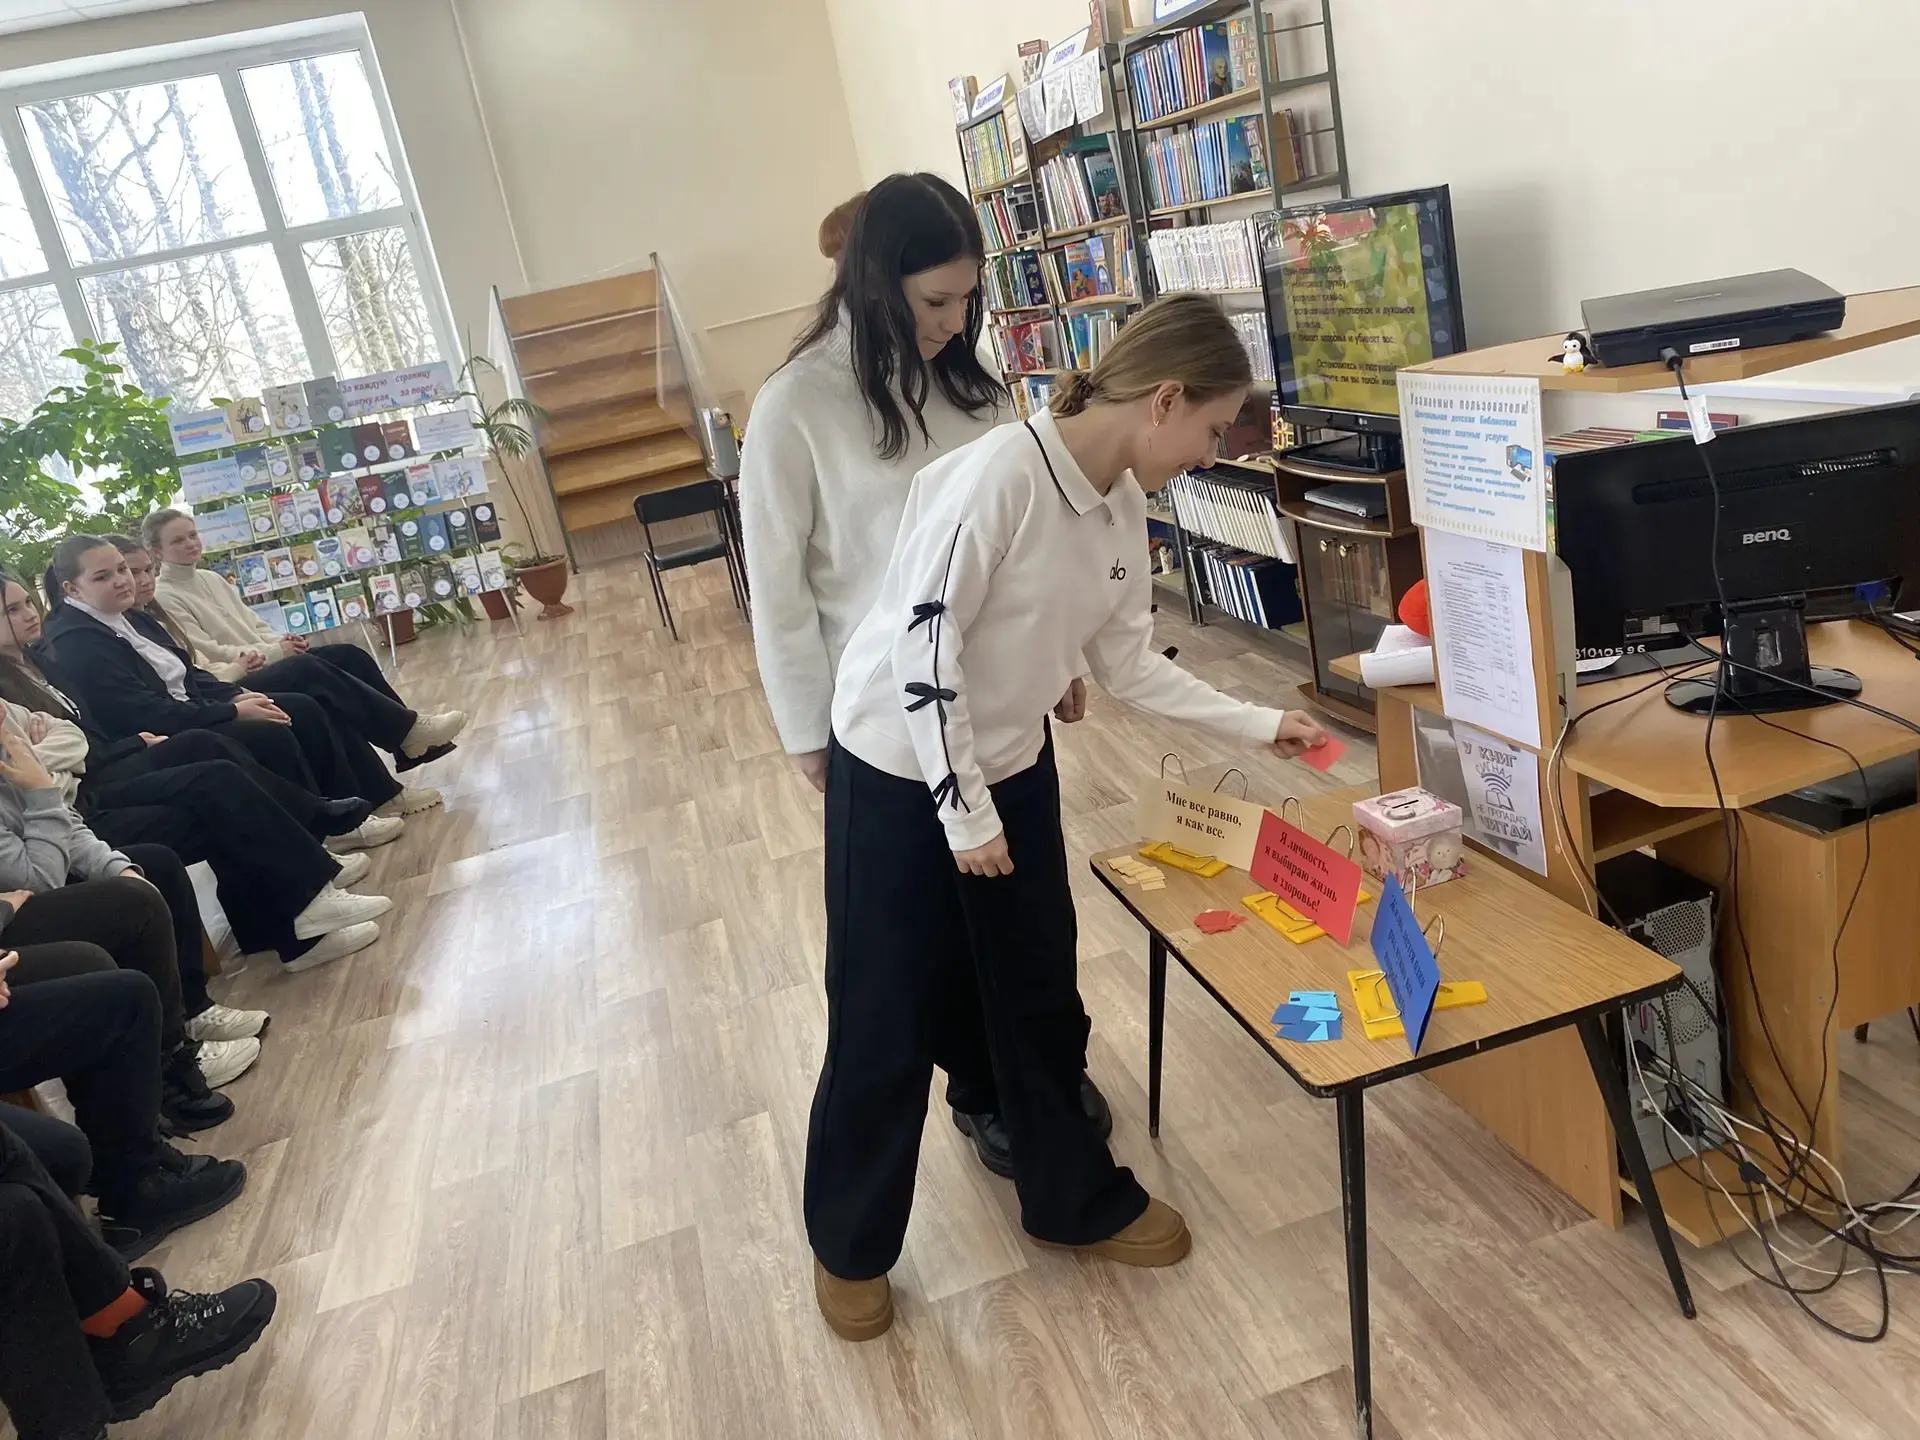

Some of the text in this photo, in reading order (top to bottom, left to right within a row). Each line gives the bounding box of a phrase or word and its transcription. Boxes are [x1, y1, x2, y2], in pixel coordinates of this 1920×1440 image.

[354, 379, 388, 391] каждую
[395, 370, 431, 384] страницу
[374, 394, 390, 403] как
[1410, 393, 1529, 414] Уважаемые пользователи!
[1743, 529, 1791, 544] BenQ
[1463, 742, 1517, 768] У КНИГ
[1475, 762, 1512, 783] СИГНАЛ
[1165, 790, 1242, 828] Мне все равно,
[1477, 803, 1528, 826] НЕ ПРОПАДАЕТ
[1176, 815, 1225, 839] я как все.
[1479, 815, 1532, 842] ЧИТАЙ
[1280, 831, 1329, 875] Я личность,
[1265, 846, 1337, 902] я выбираю жизнь
[1272, 873, 1320, 912] и здоровье!
